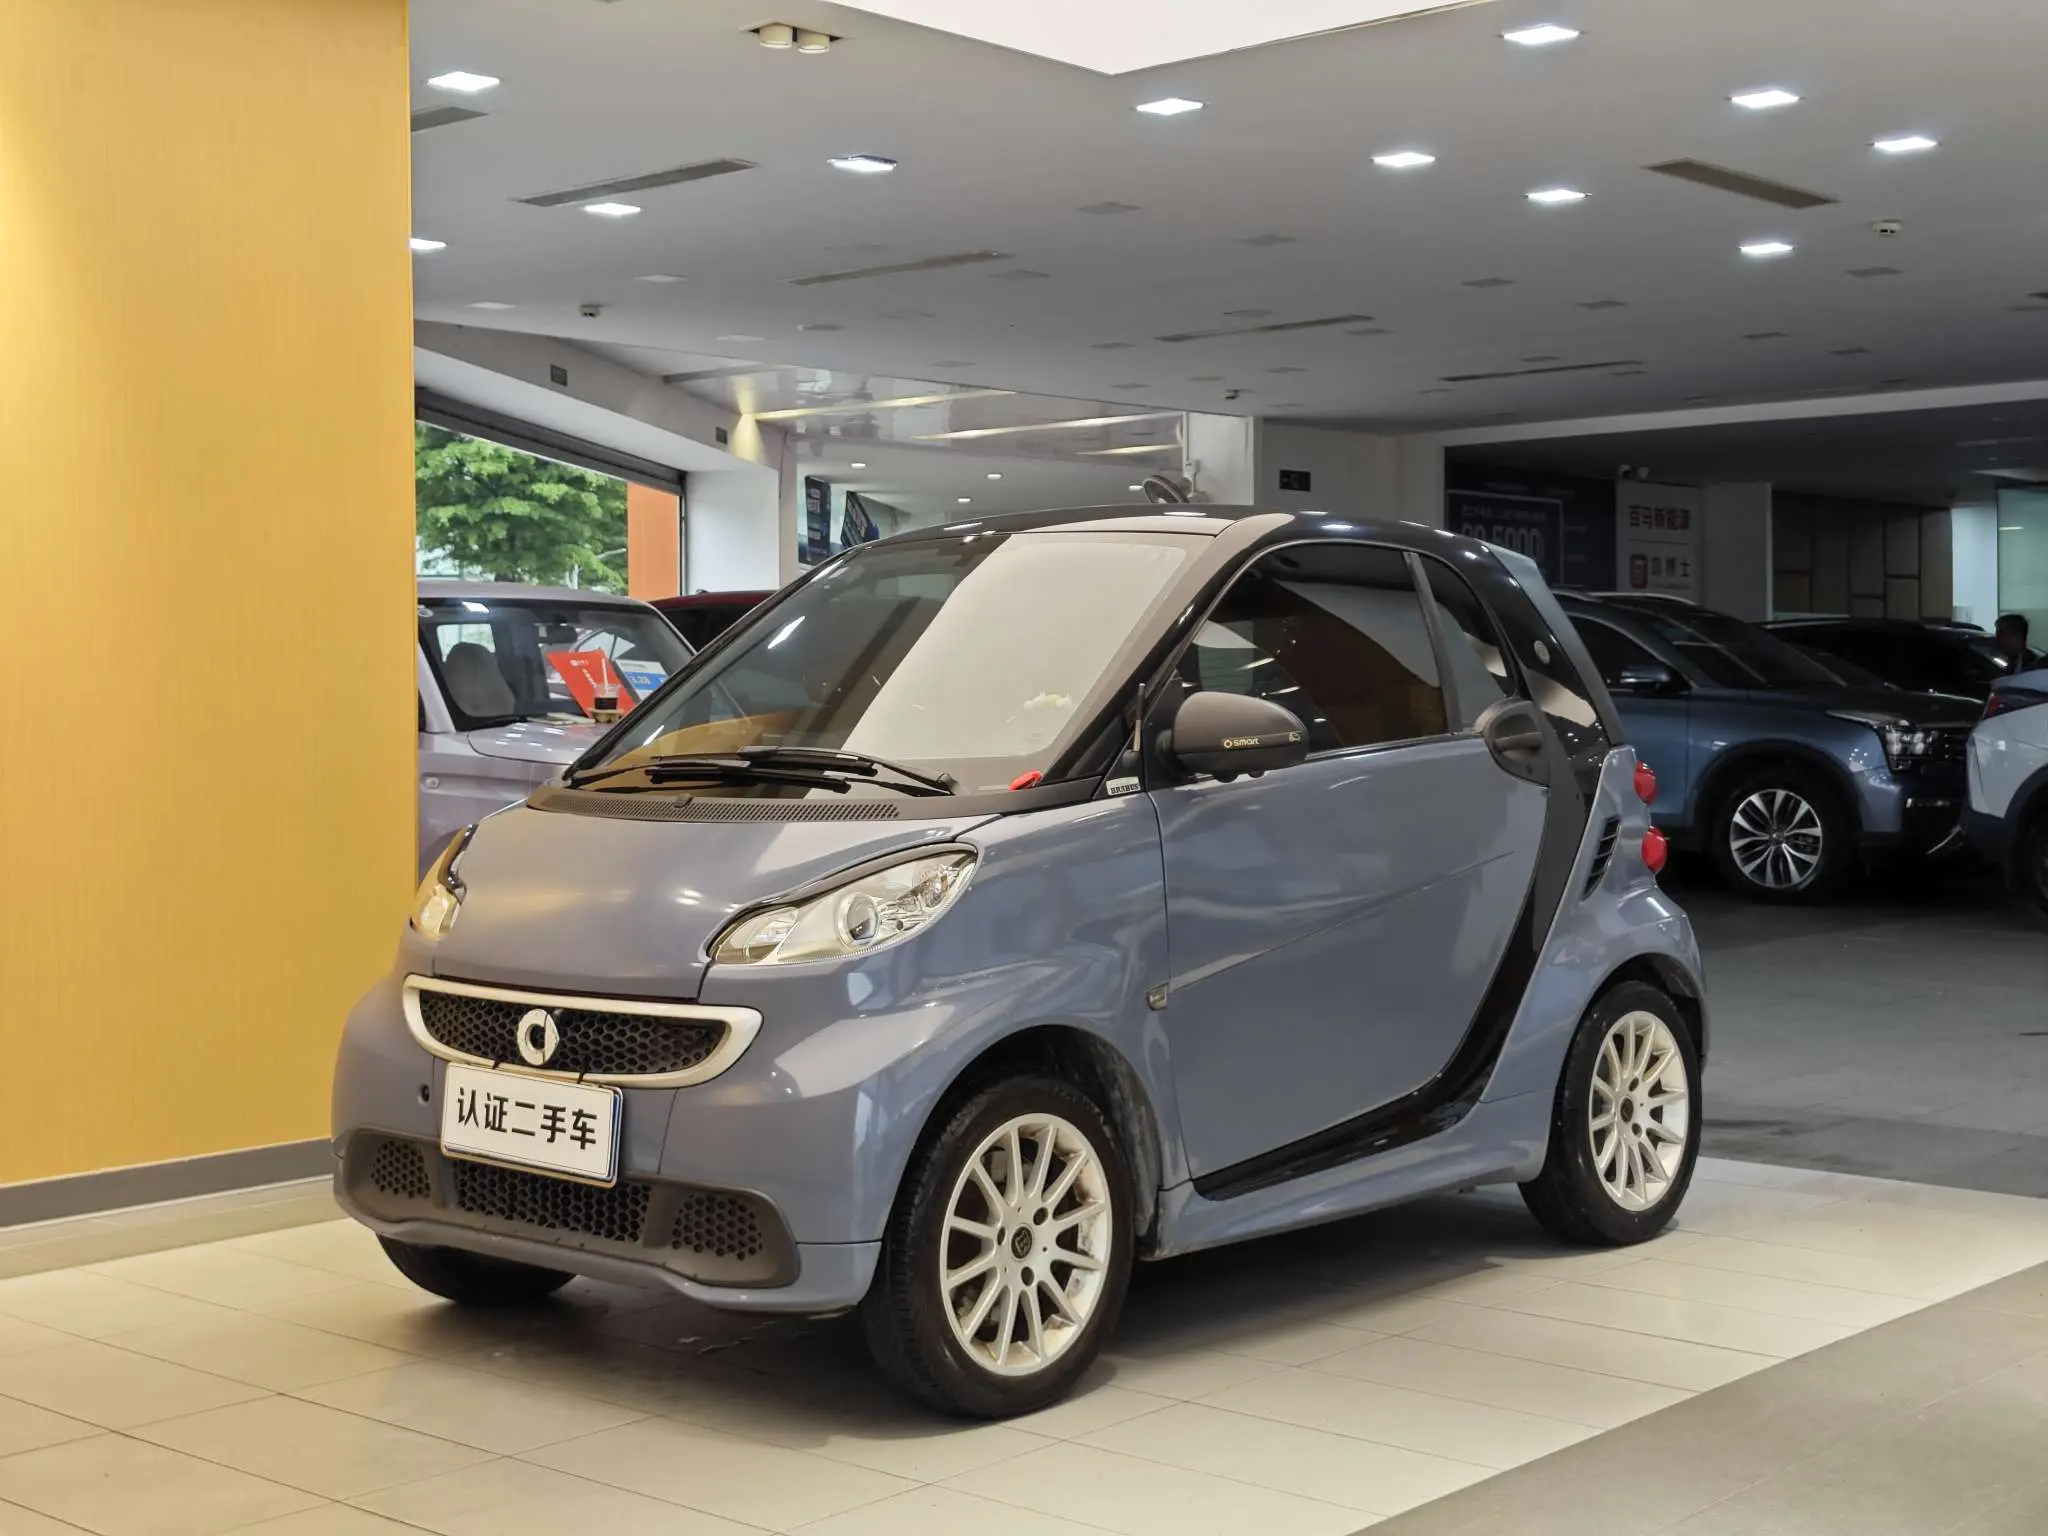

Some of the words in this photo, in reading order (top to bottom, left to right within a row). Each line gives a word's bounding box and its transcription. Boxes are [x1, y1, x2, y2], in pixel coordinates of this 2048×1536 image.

[1233, 737, 1260, 747] smart
[1110, 783, 1139, 795] BRABUS
[457, 1086, 598, 1150] 认证二手车
